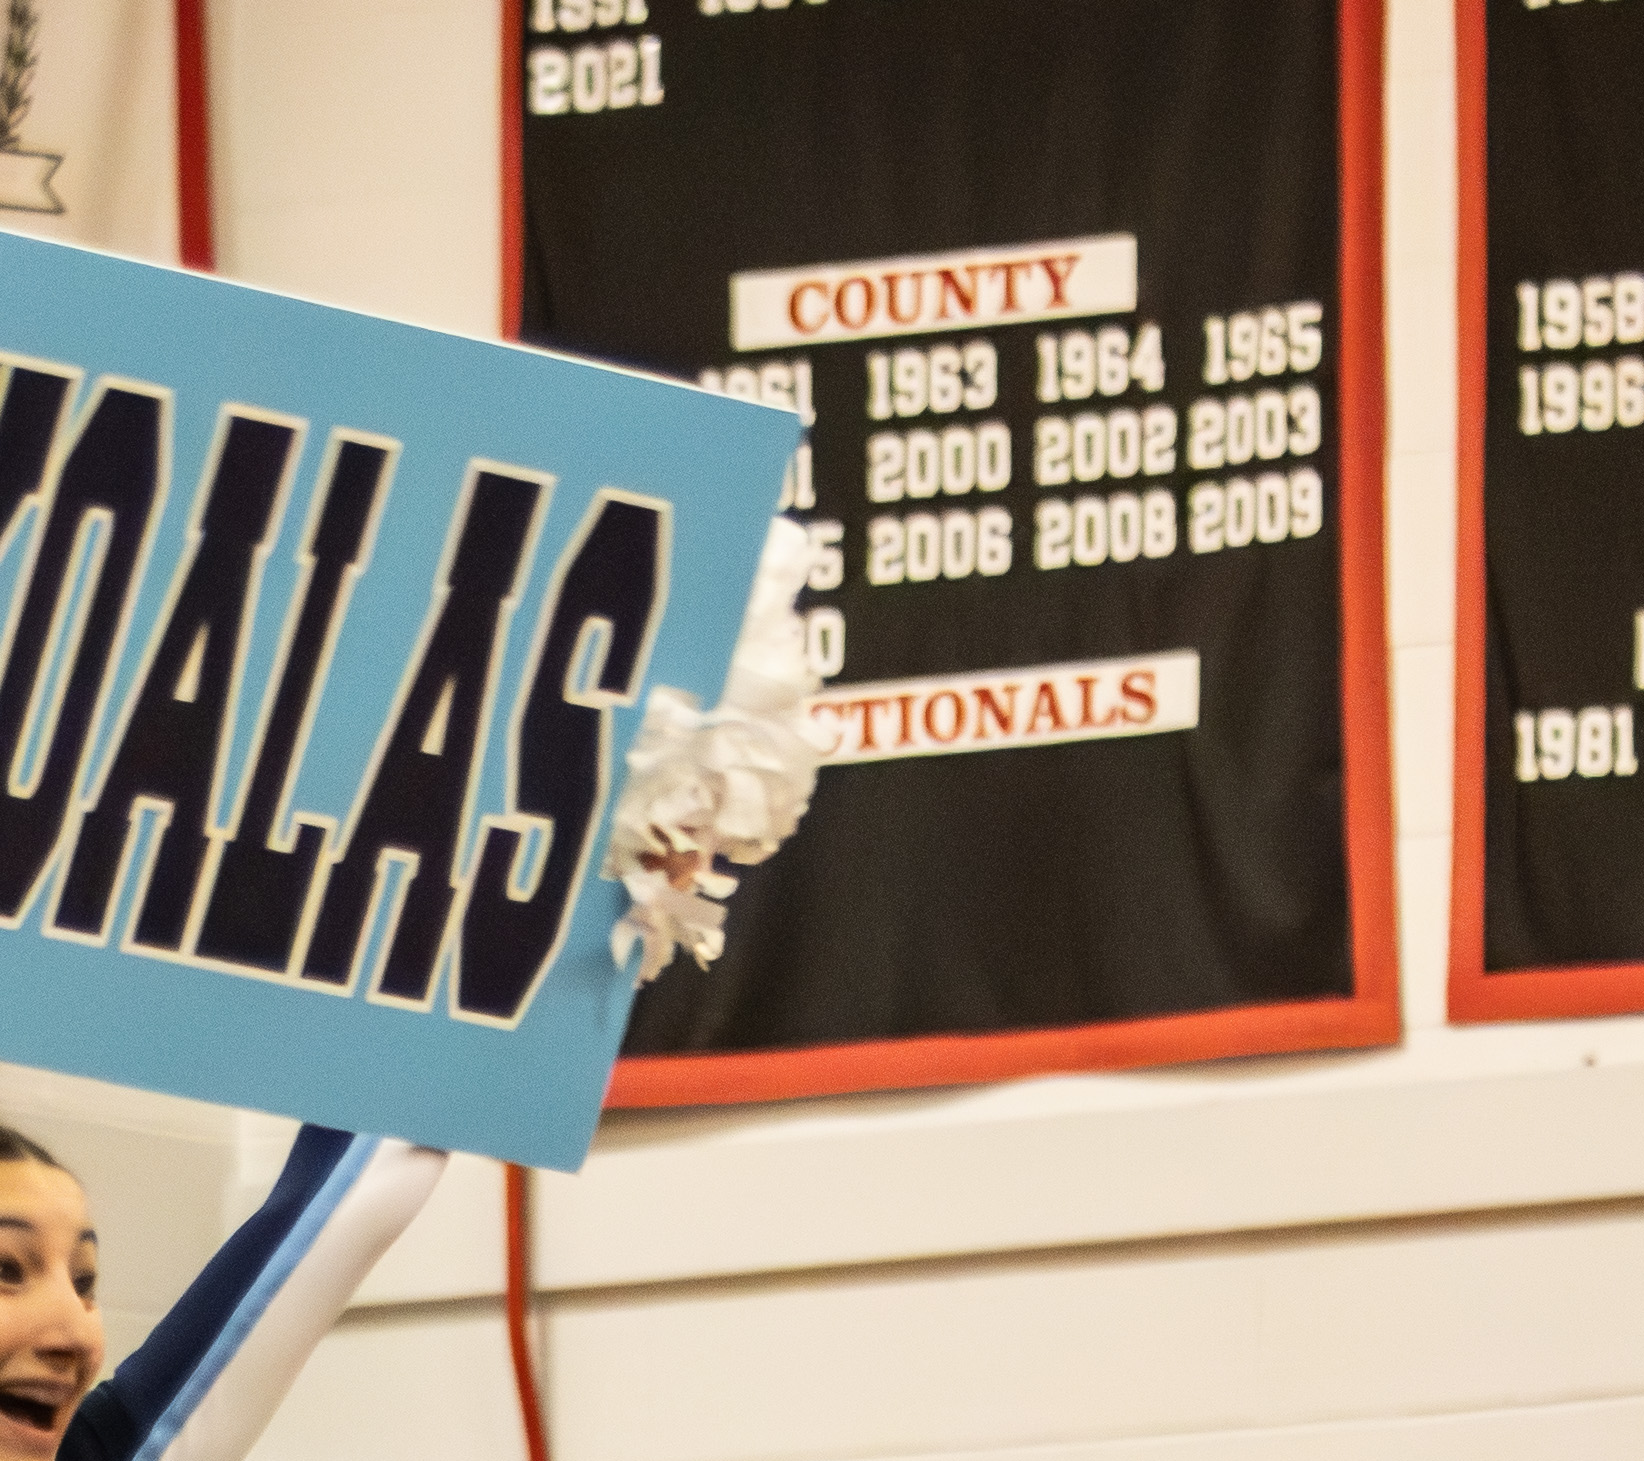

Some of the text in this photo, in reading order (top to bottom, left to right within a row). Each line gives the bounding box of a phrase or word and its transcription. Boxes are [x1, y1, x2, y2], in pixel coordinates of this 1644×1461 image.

[528, 34, 665, 116] 2021
[786, 253, 1082, 335] COUNTY
[866, 340, 1000, 421] 1963
[1034, 323, 1166, 403] 1964
[1203, 301, 1323, 386] 1965
[867, 421, 1012, 503] 2000
[1034, 404, 1178, 487] 2002
[1187, 384, 1322, 470] 2003
[866, 505, 1013, 586] 2006
[1034, 488, 1178, 571] 2008
[1188, 467, 1323, 555] 2009
[1515, 705, 1639, 782] 1981
